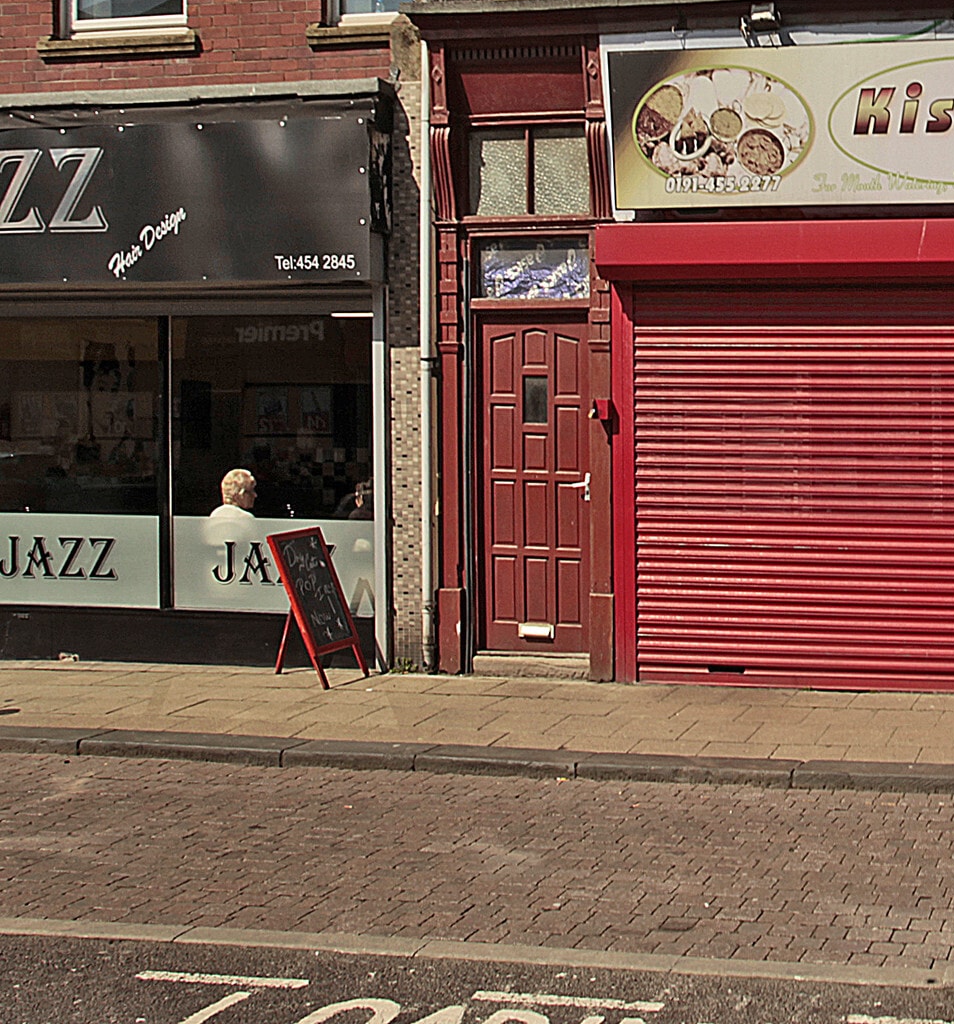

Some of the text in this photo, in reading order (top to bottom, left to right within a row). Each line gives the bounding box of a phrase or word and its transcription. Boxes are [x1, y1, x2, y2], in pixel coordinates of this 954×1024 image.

[841, 172, 883, 193] Mouth
[108, 207, 187, 278] Hair Design
[322, 254, 356, 269] 2845
[0, 536, 118, 580] JAZZ
